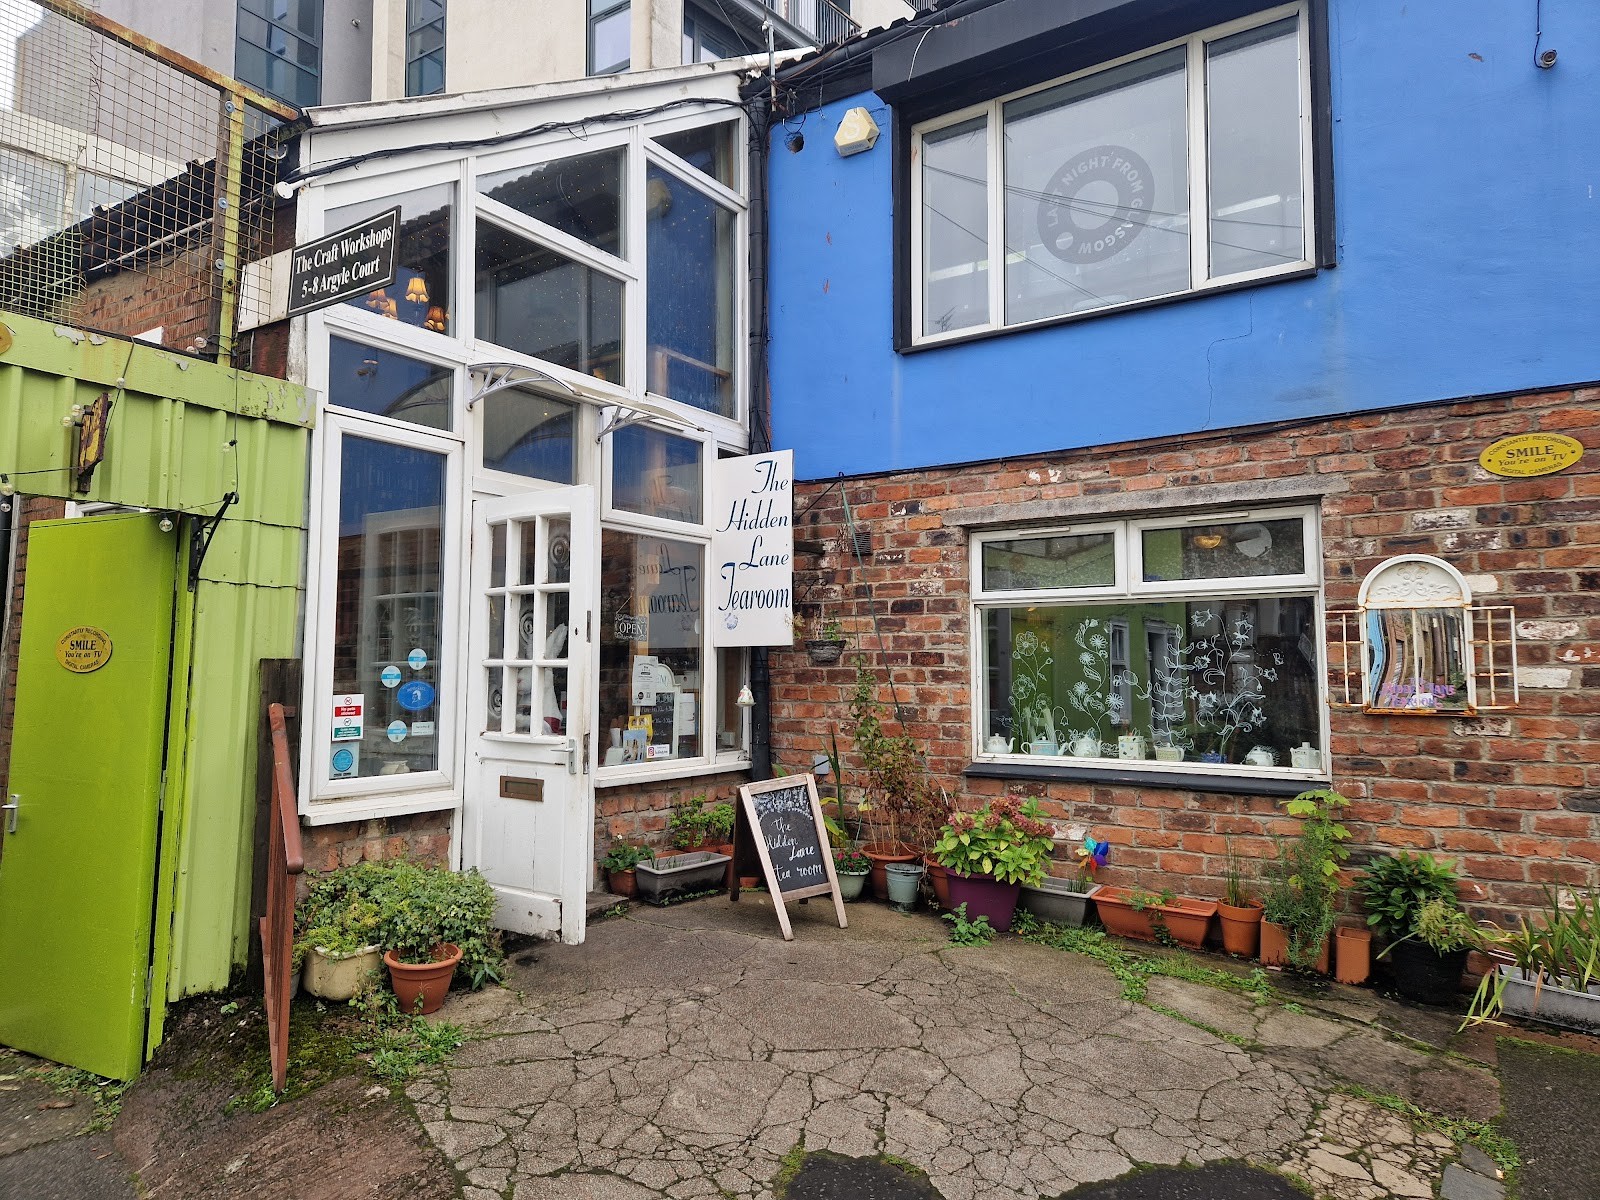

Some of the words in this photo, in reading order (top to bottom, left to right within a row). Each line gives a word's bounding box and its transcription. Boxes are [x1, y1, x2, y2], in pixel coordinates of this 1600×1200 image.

[1061, 156, 1109, 186] NIGHT
[1112, 157, 1144, 193] FROM
[295, 255, 312, 275] The
[314, 243, 339, 268] Craft
[341, 225, 392, 258] Workshops
[301, 277, 319, 299] 5-8
[319, 266, 351, 293] Argyle
[351, 255, 380, 281] Court
[1488, 436, 1530, 456] CONSTANTLY
[1532, 435, 1573, 448] RECORDING
[1506, 444, 1555, 459] SMILE
[1498, 457, 1530, 467] You're
[1552, 453, 1567, 461] TV
[1500, 466, 1526, 475] DIGITAL
[1528, 461, 1563, 475] CAMERAS
[751, 460, 789, 494] The
[716, 498, 789, 533] Hidden
[738, 534, 789, 571] Lane
[718, 562, 790, 612] Tearoom
[619, 622, 643, 635] OPEN
[69, 640, 97, 650] SMILE
[93, 650, 103, 658] TV
[764, 834, 799, 852] Hidden
[789, 846, 815, 861] Lane
[773, 864, 792, 882] tea
[796, 864, 823, 877] room
